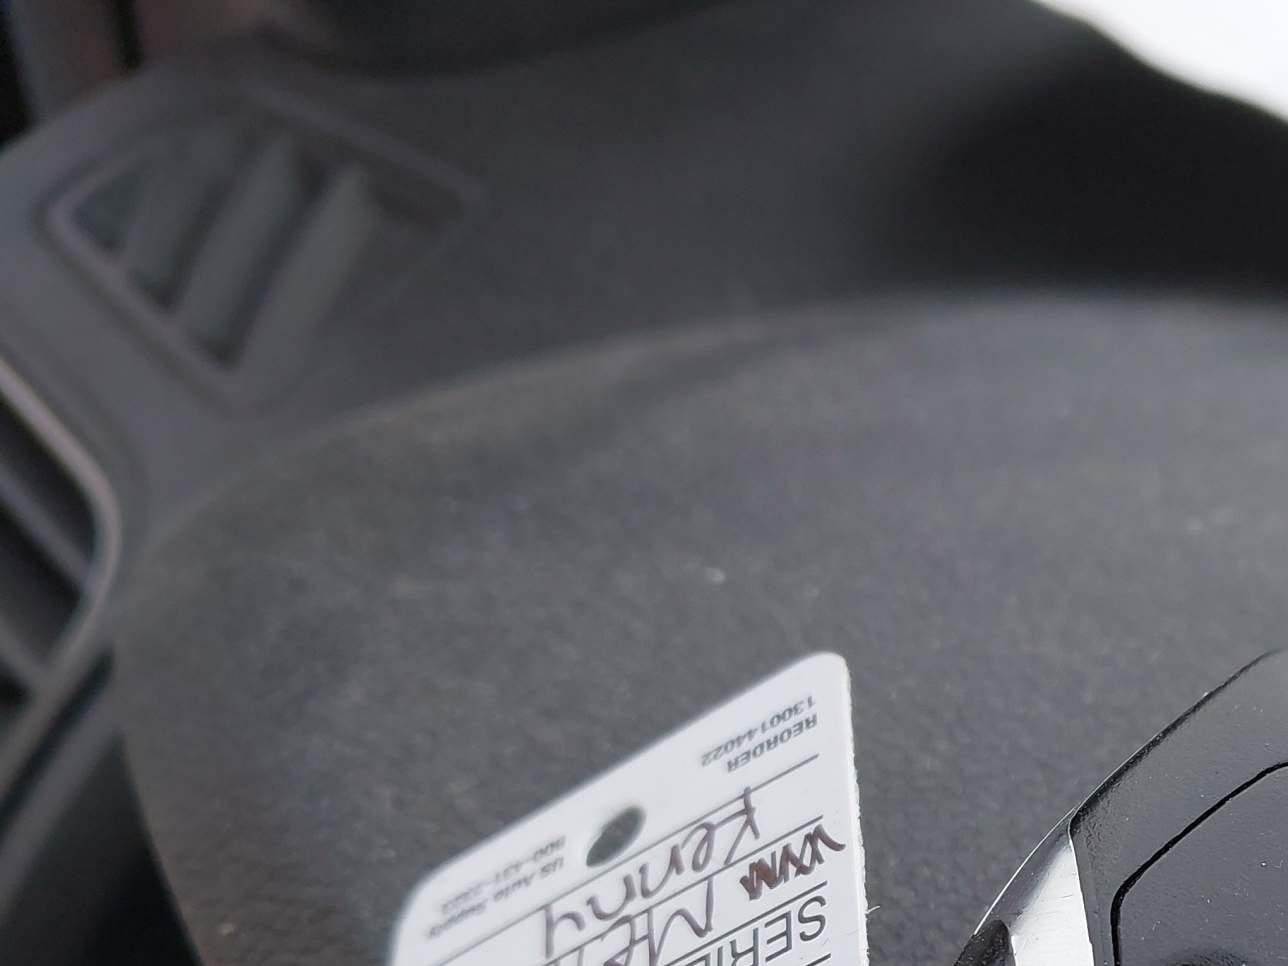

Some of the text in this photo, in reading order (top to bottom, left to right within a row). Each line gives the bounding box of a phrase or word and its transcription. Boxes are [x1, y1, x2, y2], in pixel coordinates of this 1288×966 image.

[726, 713, 818, 774] REORDER
[492, 872, 536, 903] Auto
[545, 787, 761, 959] Kenny
